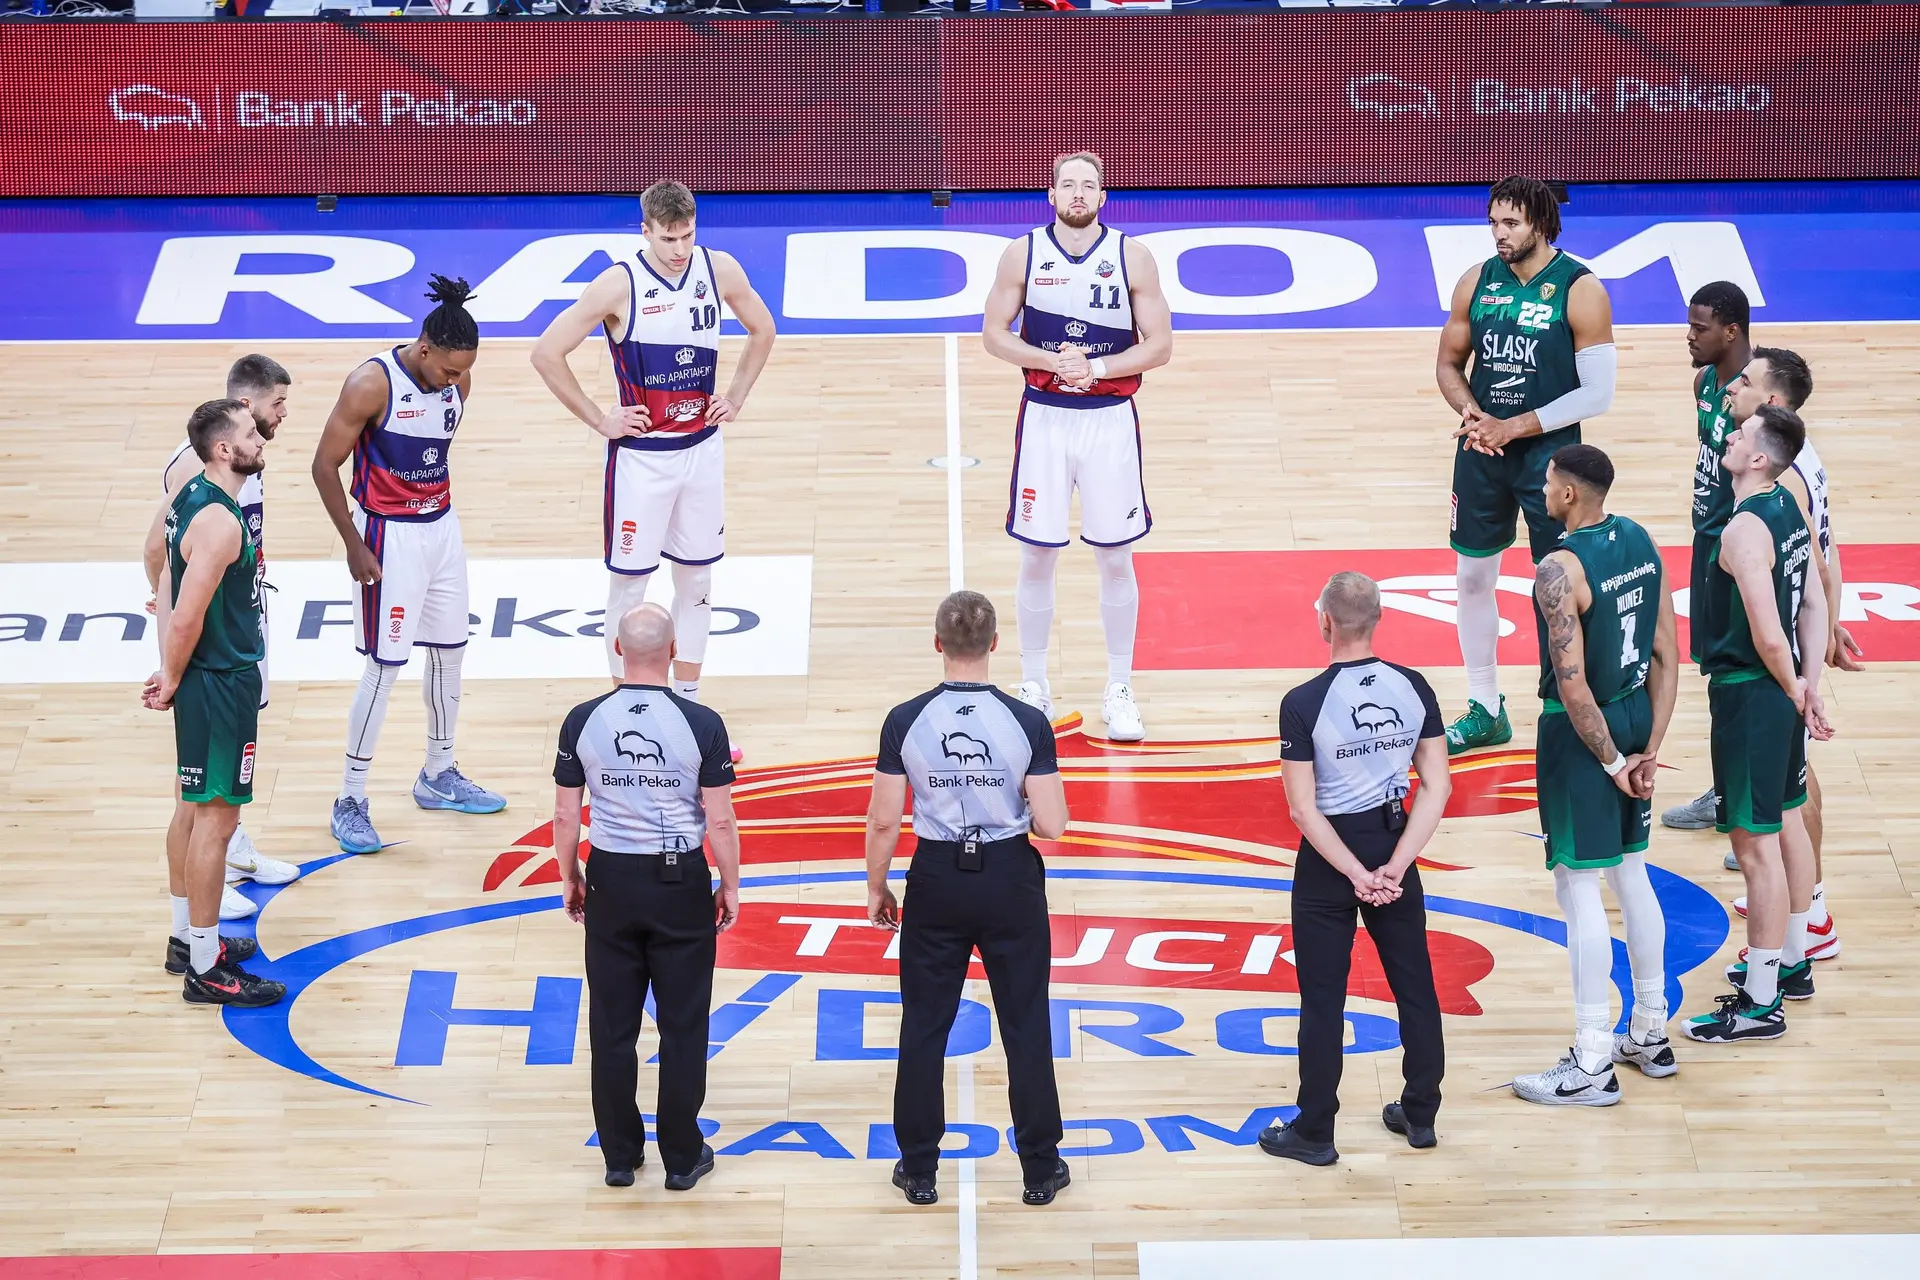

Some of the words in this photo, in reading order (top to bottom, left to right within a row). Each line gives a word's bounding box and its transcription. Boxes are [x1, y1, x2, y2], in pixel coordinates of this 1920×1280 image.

[1473, 75, 1600, 115] Bank
[1614, 75, 1772, 114] Pekao
[239, 89, 367, 128] Bank
[381, 89, 537, 127] Pekao
[136, 221, 1767, 325] RADOM
[1040, 262, 1055, 271] 4F
[645, 288, 659, 299] 4F
[1089, 283, 1121, 310] 11
[689, 304, 716, 331] 10
[1517, 301, 1553, 330] 22
[1041, 341, 1060, 351] KING
[1482, 329, 1539, 368] ŚLĄSK
[644, 373, 666, 387] KING
[443, 408, 457, 433] 8
[1712, 414, 1727, 443] 5
[389, 466, 410, 482] KING
[1616, 586, 1644, 615] NUNEZ
[1620, 611, 1640, 669] 1
[1359, 674, 1377, 687] 4F
[628, 703, 650, 715] 4F
[956, 705, 977, 716] 4F
[1336, 744, 1371, 760] Bank
[1374, 737, 1414, 753] Pekao
[601, 773, 635, 788] Bank
[638, 775, 681, 788] Pekao
[928, 776, 963, 788] Bank
[965, 775, 1006, 788] Pekao
[1764, 957, 1781, 967] 4F
[394, 970, 1403, 1067] HYDRO
[585, 1104, 1303, 1160] RADOM
